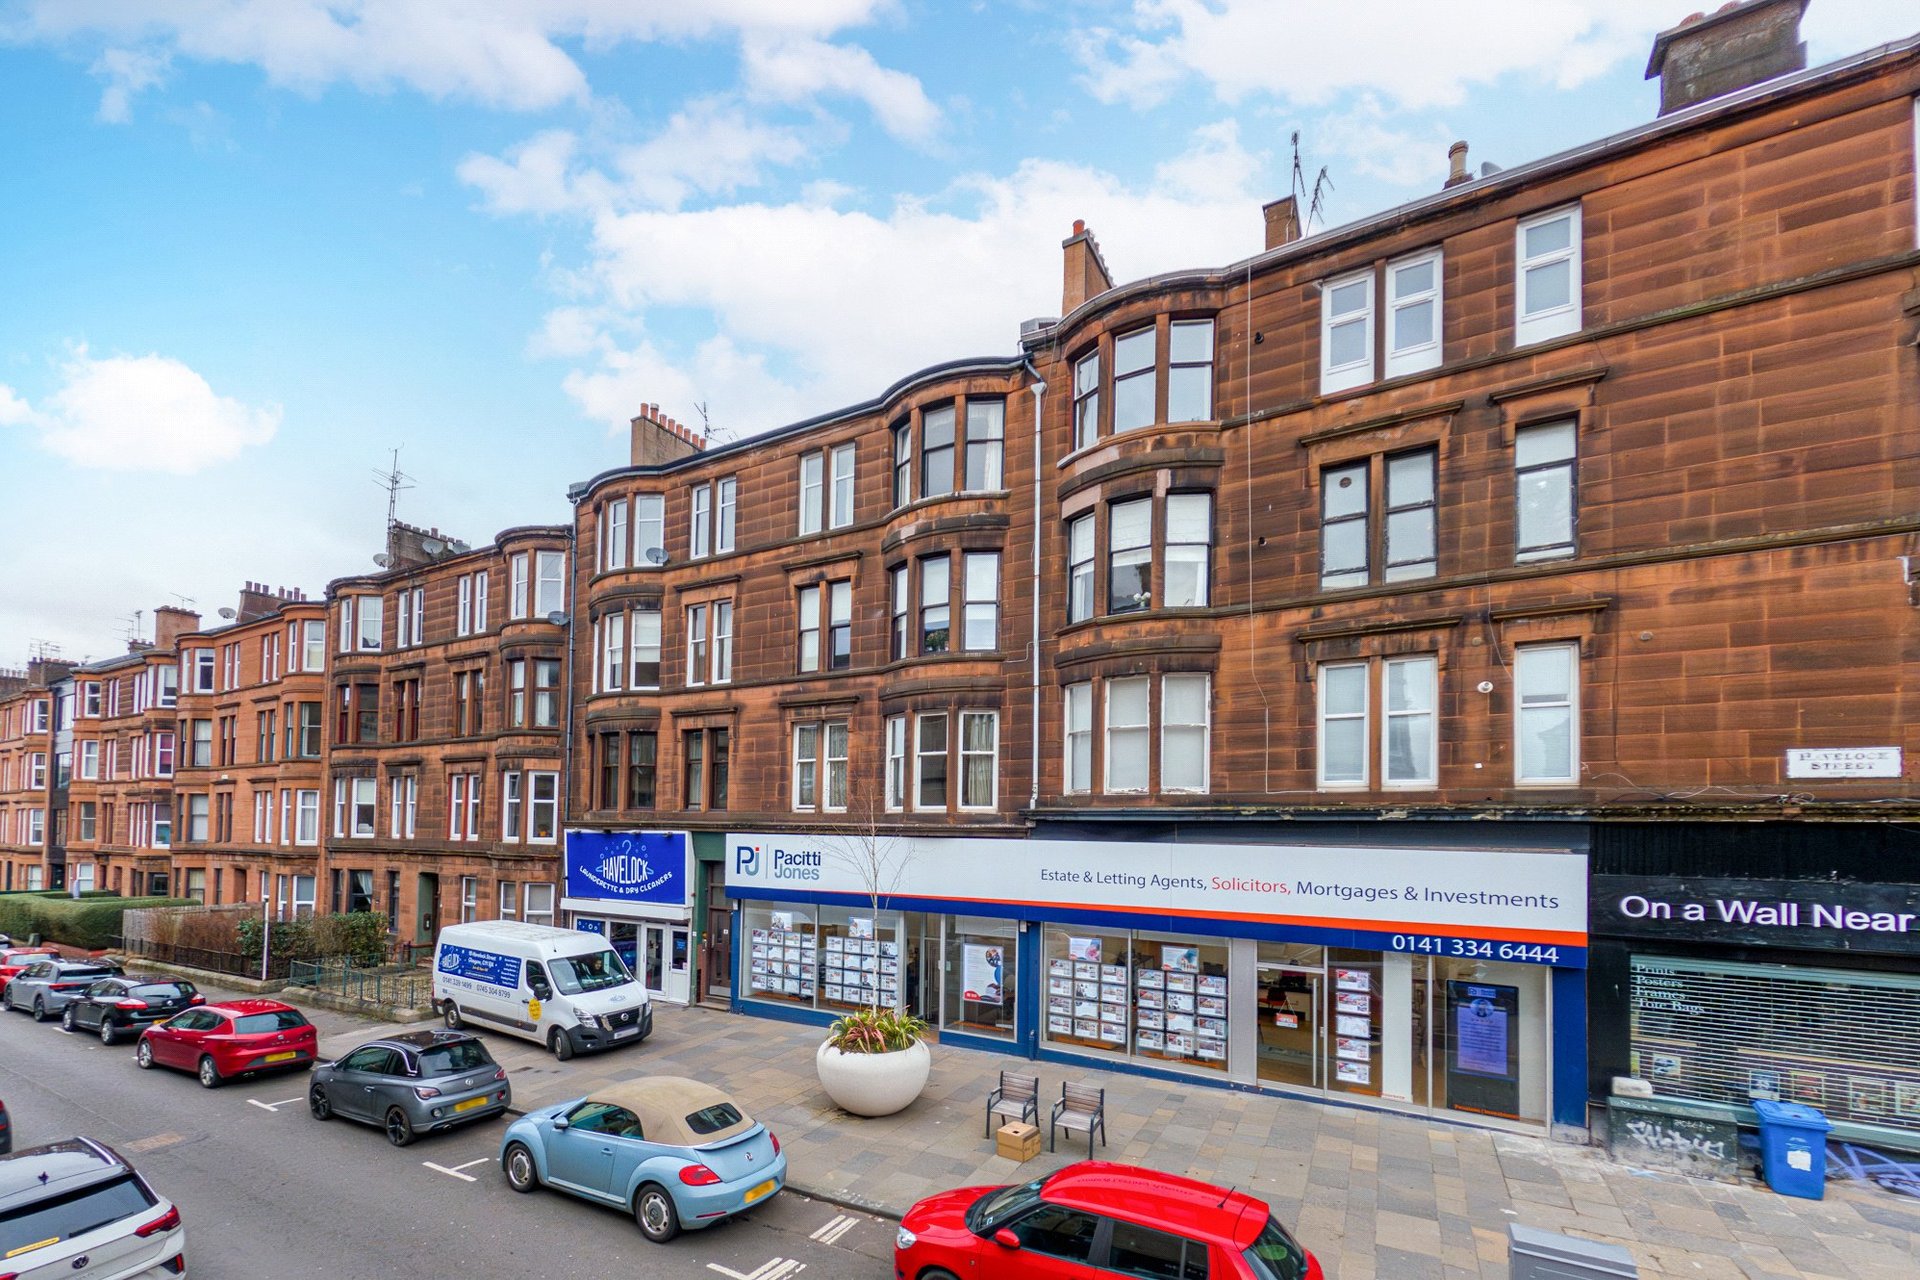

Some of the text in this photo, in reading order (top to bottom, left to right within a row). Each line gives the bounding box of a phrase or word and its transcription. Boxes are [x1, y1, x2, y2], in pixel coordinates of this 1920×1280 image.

[1800, 753, 1889, 761] HVELOCK
[774, 849, 821, 869] Pacitti
[580, 865, 618, 893] LAUNDERETTE
[640, 871, 673, 892] CLEANERS
[602, 855, 648, 884] HAVELOCK
[774, 863, 820, 880] Jones
[1041, 869, 1559, 909] Estate & Letting Agents, Solicitors, Mortgages & Investments
[1620, 895, 1915, 932] On a Wall Near
[1392, 934, 1559, 963] 0141 334 6444
[1636, 963, 1676, 975] Prints
[1636, 975, 1683, 988] Posters
[1636, 986, 1686, 1000] Frames
[1635, 997, 1705, 1015] Tote Bags
